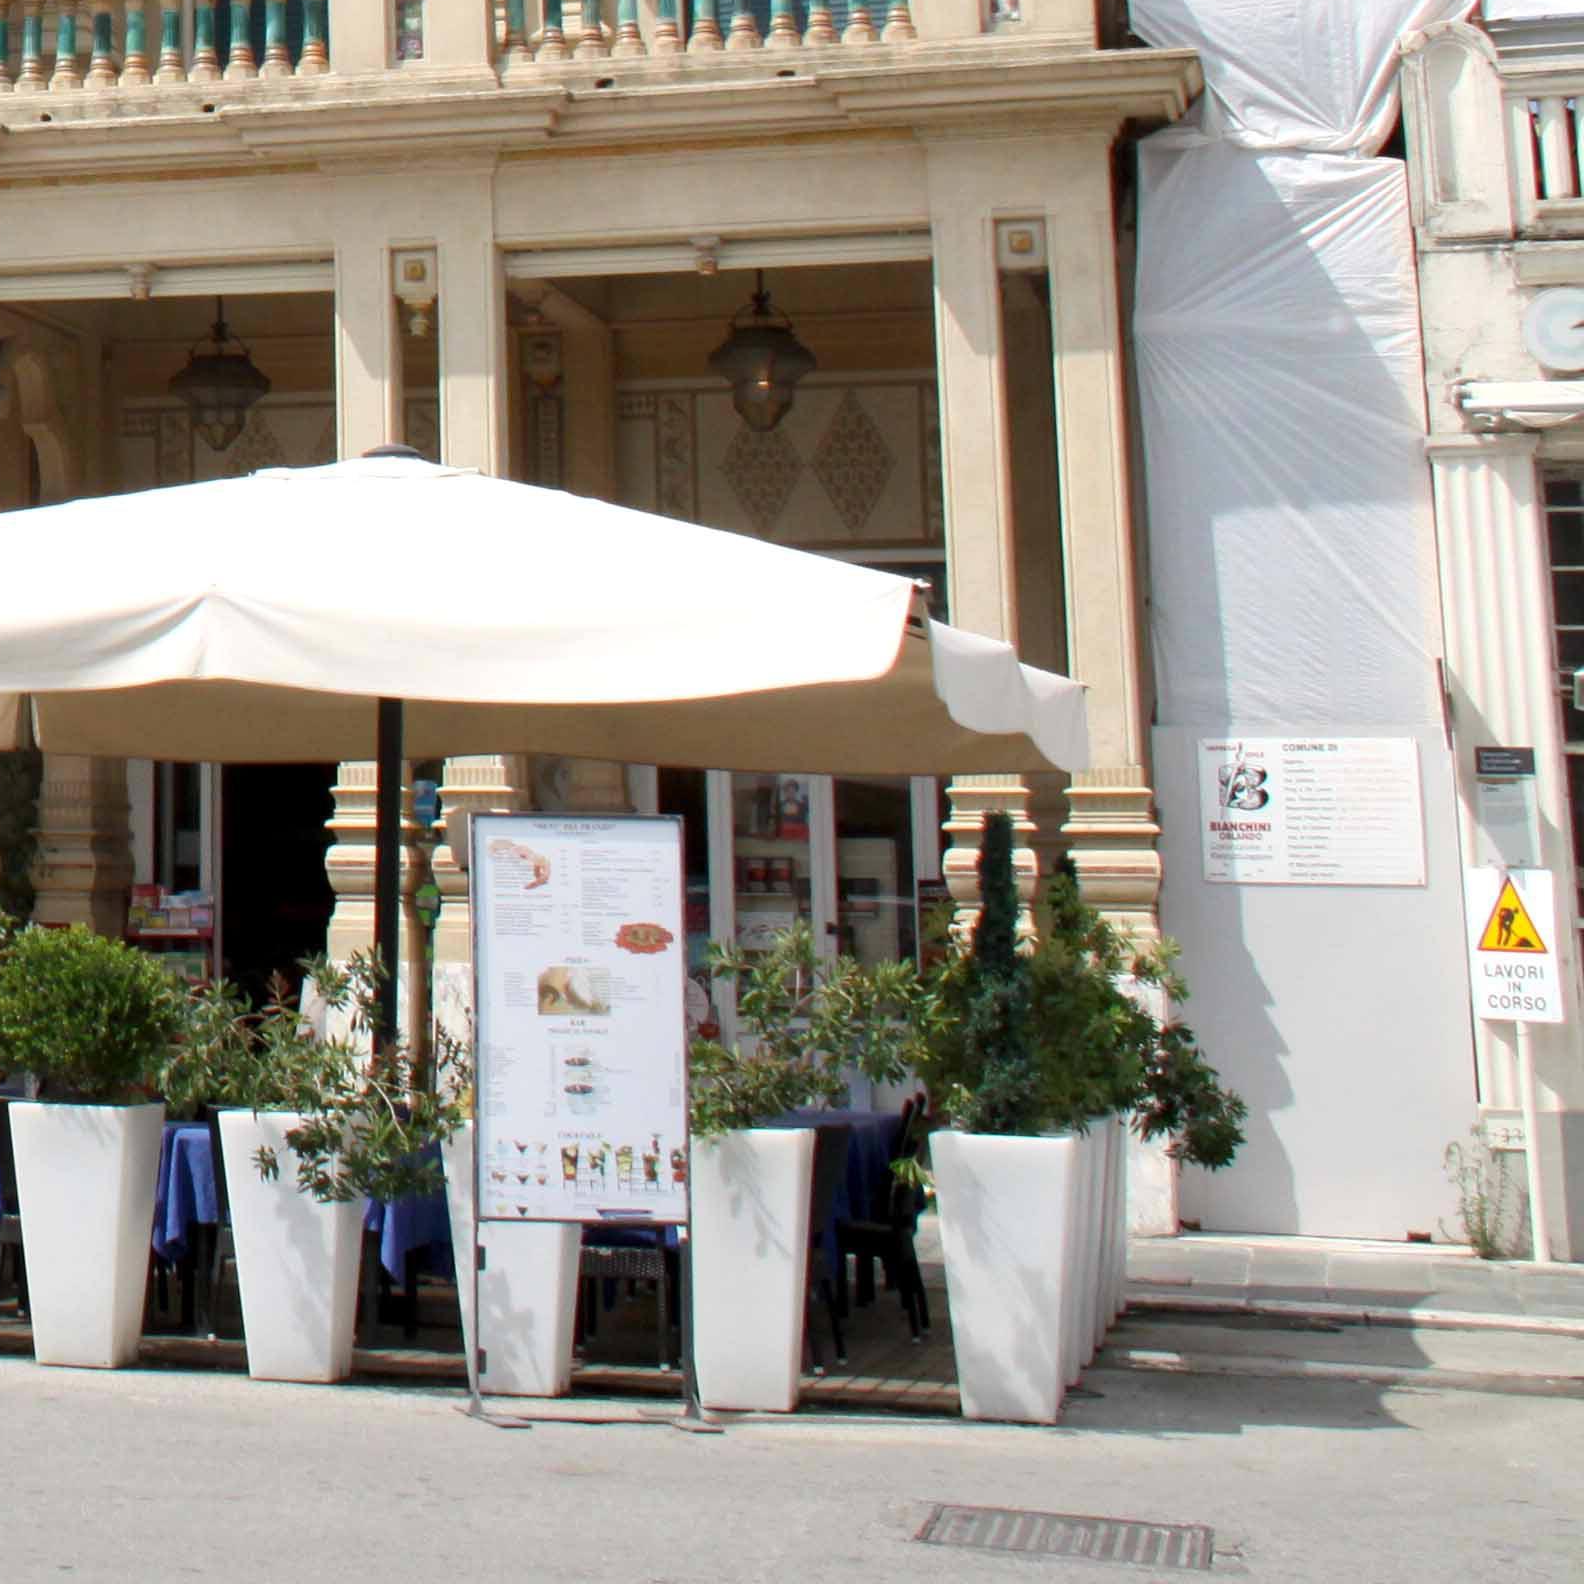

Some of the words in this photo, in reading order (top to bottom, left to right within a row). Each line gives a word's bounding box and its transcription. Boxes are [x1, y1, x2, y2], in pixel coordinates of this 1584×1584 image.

[1281, 743, 1325, 752] COMUNE
[1209, 821, 1272, 832] BIANCHINI
[1483, 962, 1545, 981] LAVORI
[1507, 980, 1522, 993] IN
[1487, 993, 1548, 1012] CORSO
